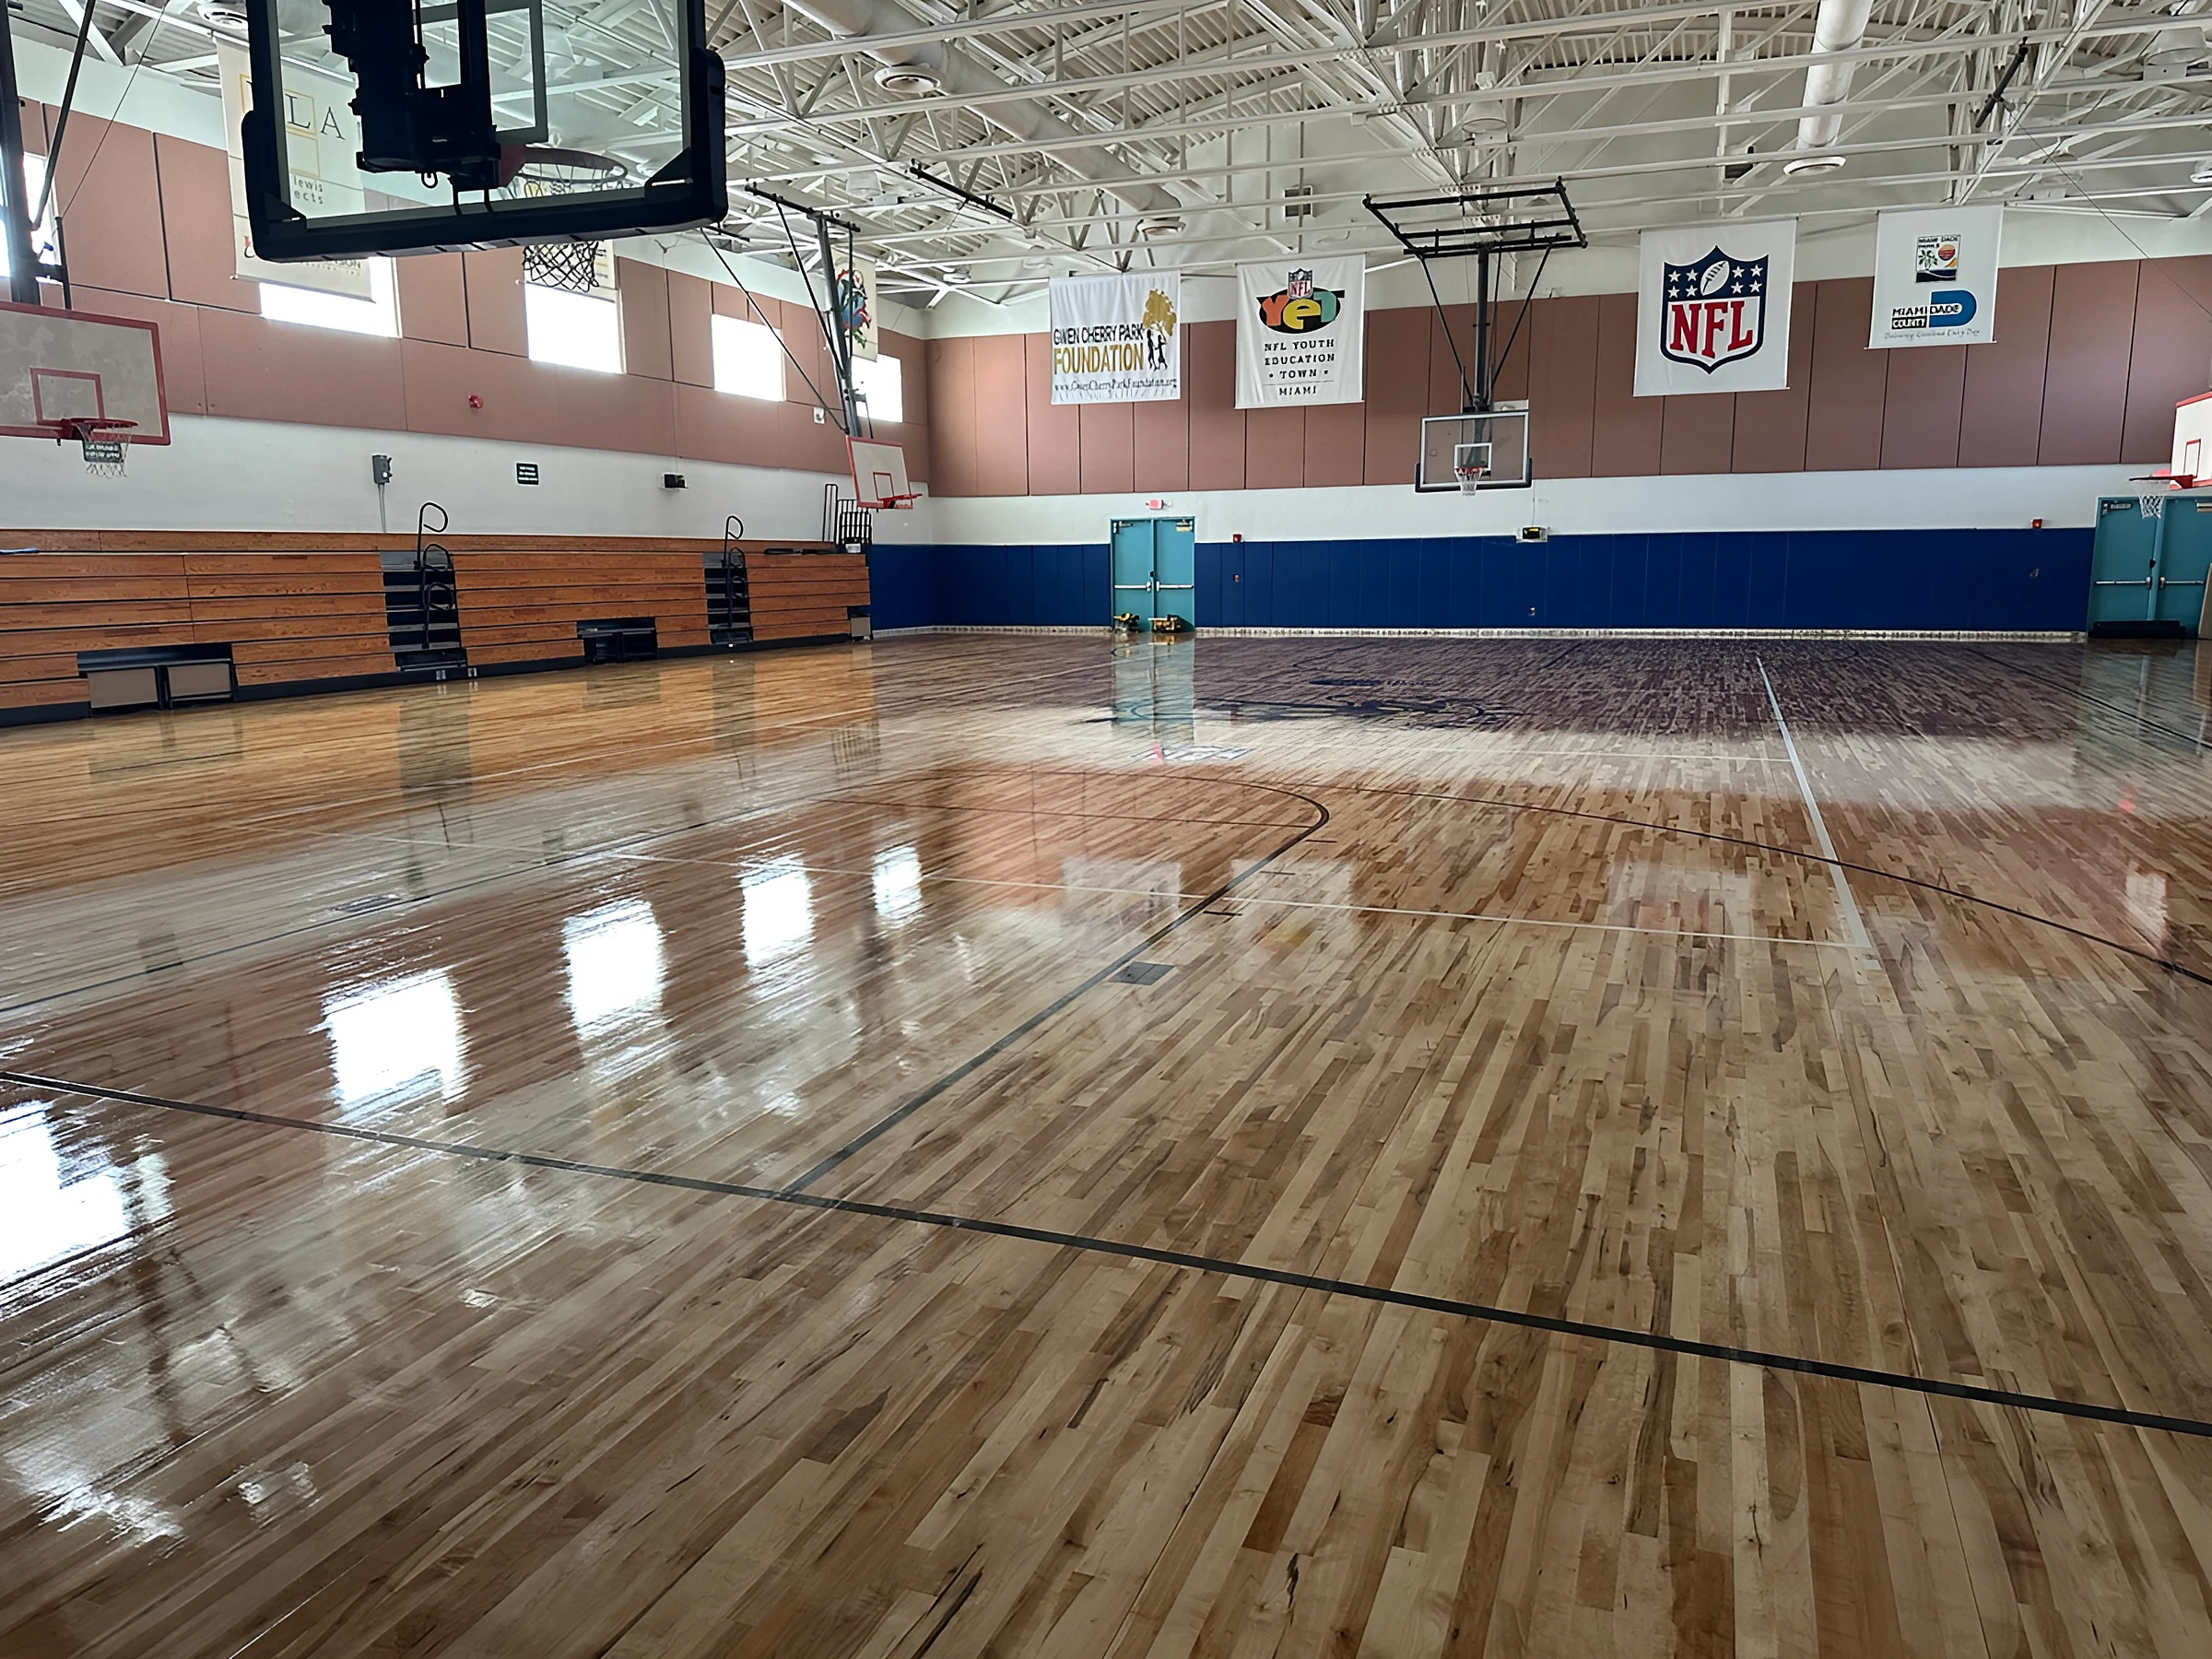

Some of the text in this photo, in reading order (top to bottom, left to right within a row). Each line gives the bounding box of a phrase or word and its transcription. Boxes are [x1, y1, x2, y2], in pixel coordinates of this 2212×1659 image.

[1290, 280, 1312, 297] NFL
[1669, 300, 1753, 359] NFL
[1892, 319, 1926, 328] COUNTY
[1053, 323, 1144, 345] GWEN CHERRY PARK
[1265, 338, 1335, 351] NFL YOUTH
[1053, 343, 1144, 375] FOUNDATION
[1265, 353, 1335, 366] EDUCATION
[1279, 369, 1317, 379] TOWN
[1279, 385, 1316, 395] MIAMI
